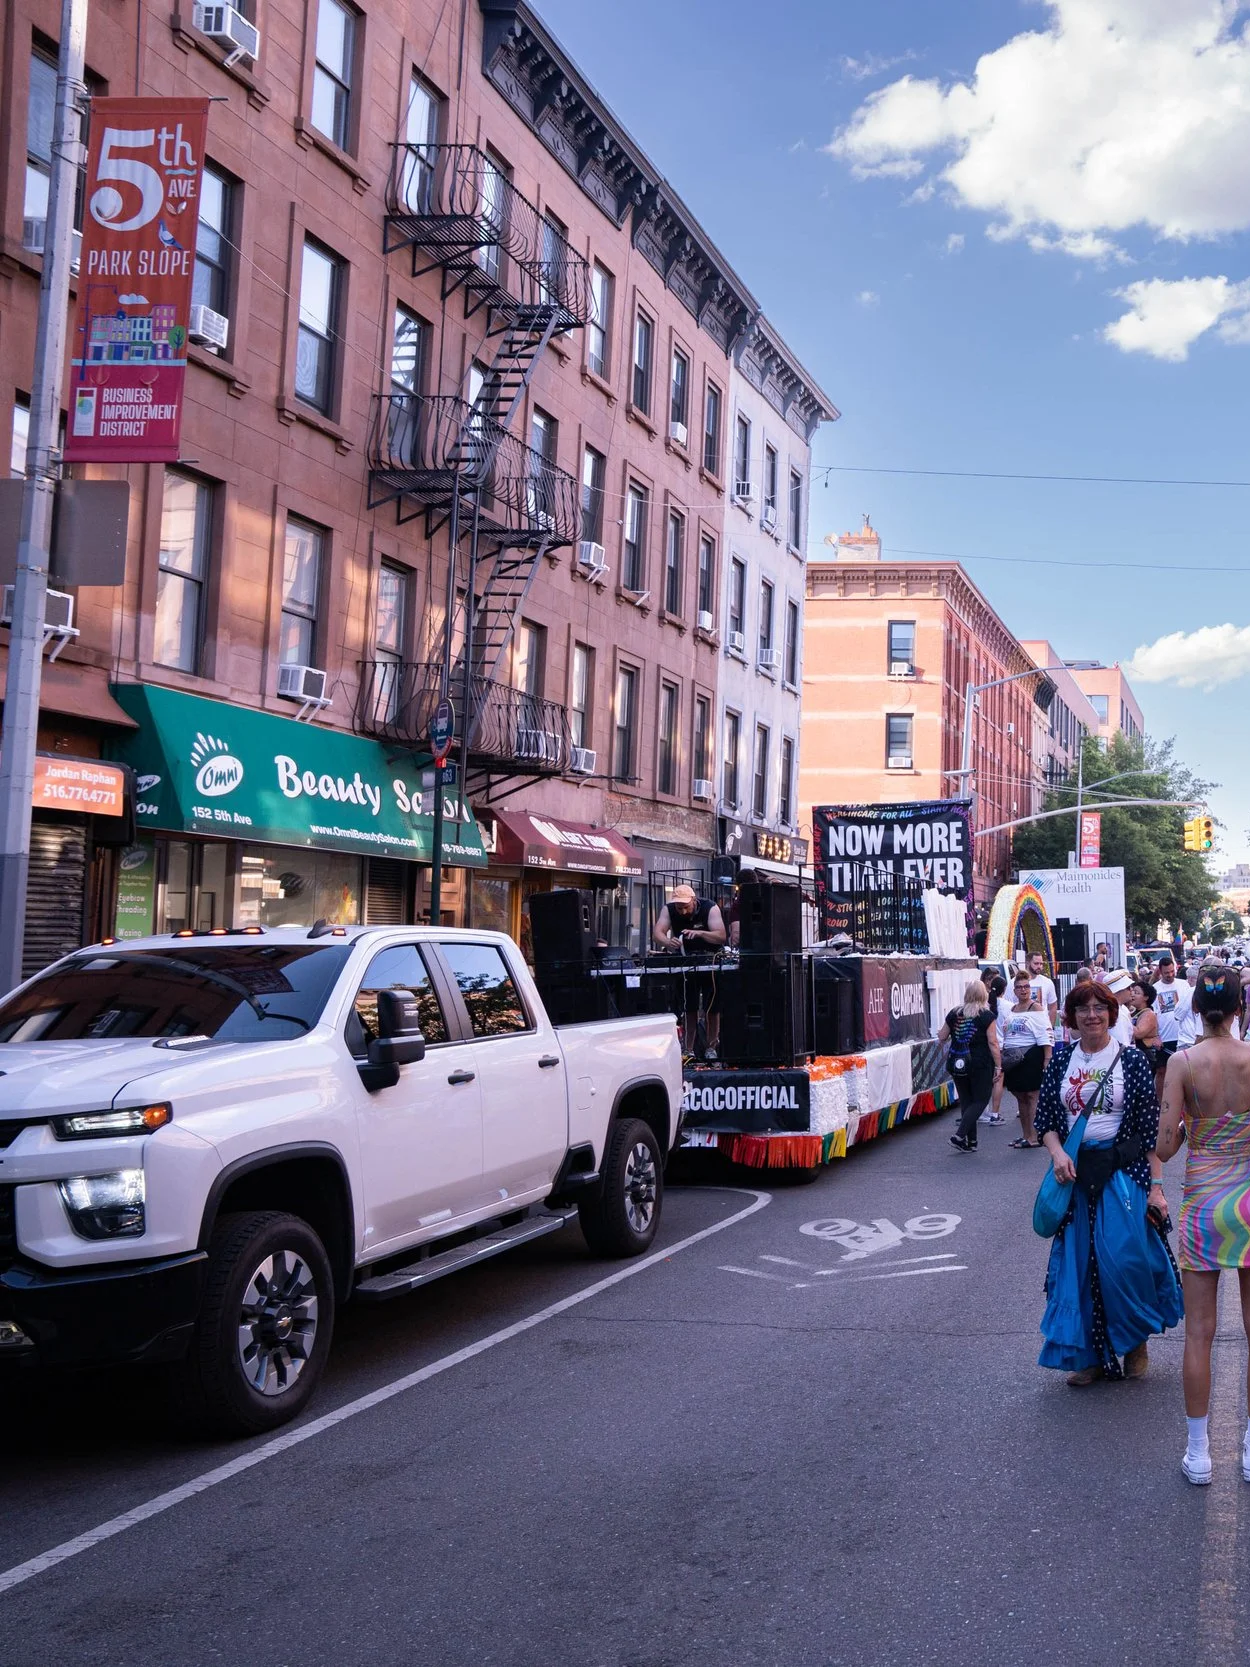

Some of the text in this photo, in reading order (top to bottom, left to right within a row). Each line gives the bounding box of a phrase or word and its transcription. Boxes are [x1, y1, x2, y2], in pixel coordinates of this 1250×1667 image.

[90, 123, 197, 231] 5th
[167, 179, 197, 198] AVE.
[88, 249, 190, 276] PARK SLOPE
[102, 388, 153, 403] BUSINESS
[101, 404, 178, 420] IMPROVEMENT
[99, 421, 146, 437] DISTRICT
[45, 765, 116, 786] Jordan Raphan
[202, 766, 238, 790] Omni
[43, 784, 116, 805] 516.776.4771
[274, 754, 471, 823] Beauty Saon
[192, 806, 252, 825] 152 5th Ave
[881, 811, 897, 820] FOR
[899, 809, 914, 819] ALL
[310, 824, 418, 847] www.OmniBeautySalon.com
[828, 825, 885, 857] NOW
[893, 822, 963, 855] MORE
[527, 855, 538, 865] 152
[828, 859, 894, 892] THAN
[903, 858, 965, 890] EVER
[1057, 870, 1121, 882] Maimonides
[1057, 882, 1092, 894] Health
[118, 893, 146, 904] Eyebrow
[868, 988, 885, 1014] AHF
